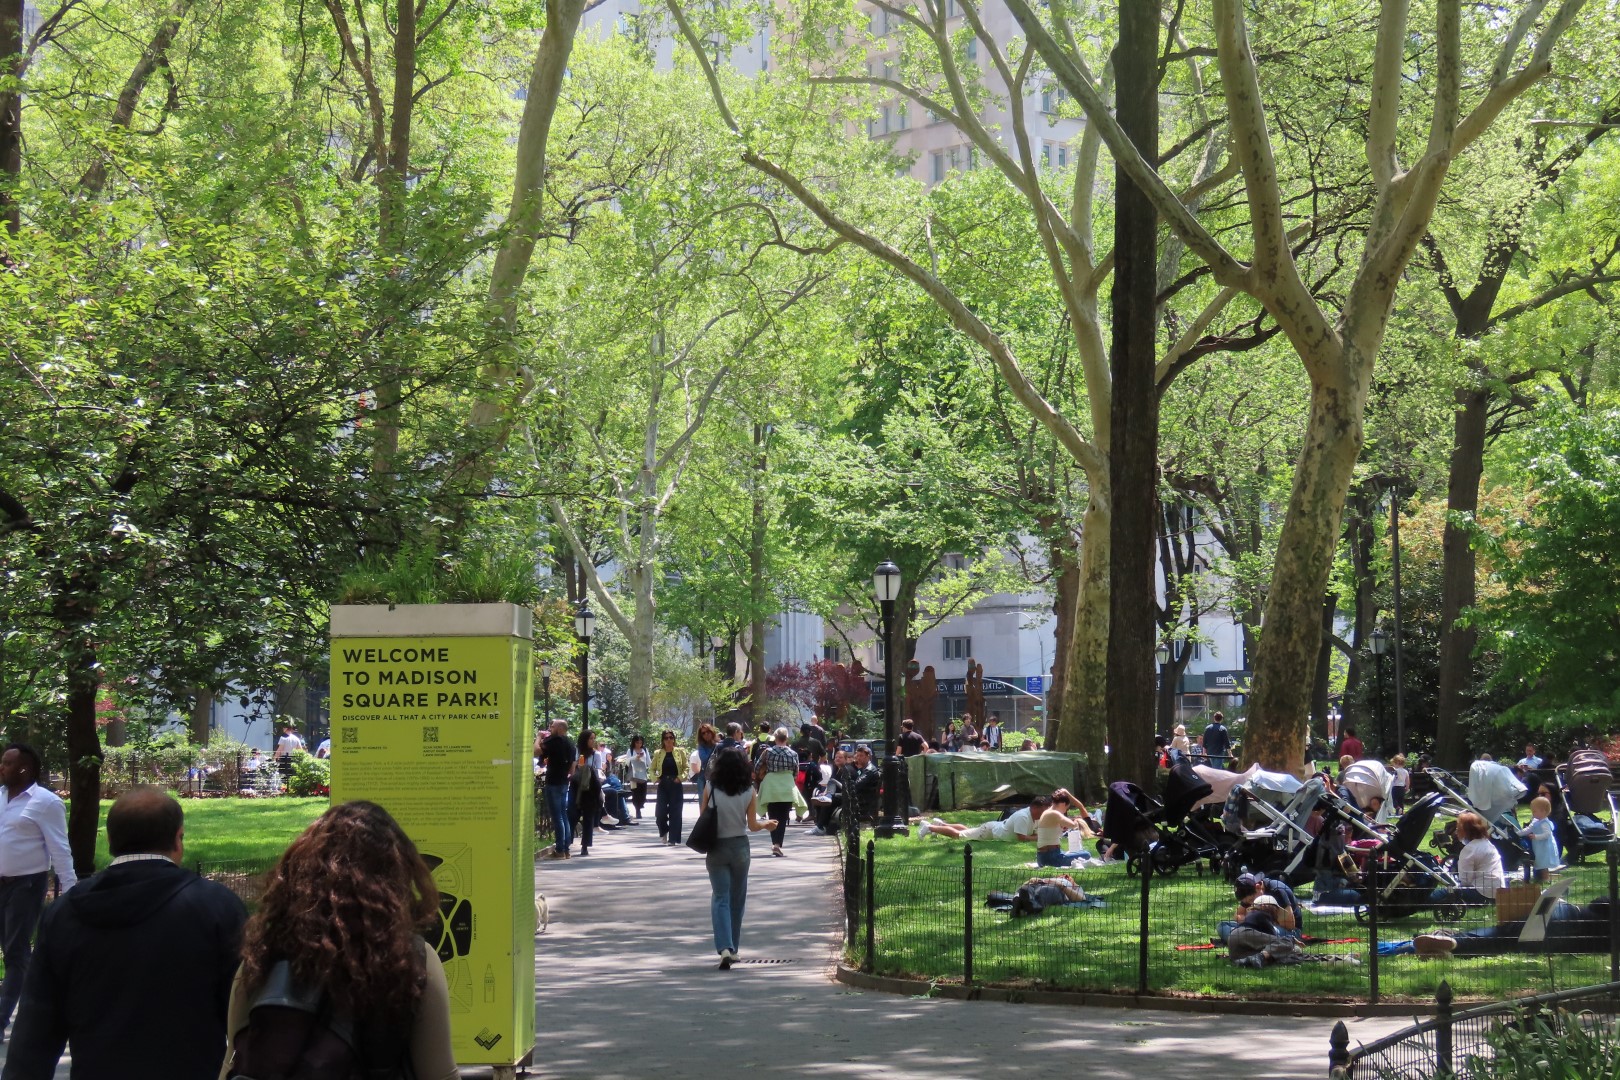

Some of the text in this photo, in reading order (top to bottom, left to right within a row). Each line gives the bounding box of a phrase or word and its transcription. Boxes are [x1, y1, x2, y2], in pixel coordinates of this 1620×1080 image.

[342, 647, 449, 663] WELCOME
[342, 670, 477, 686] TO MADISON
[342, 692, 498, 708] SQUARE PARK!
